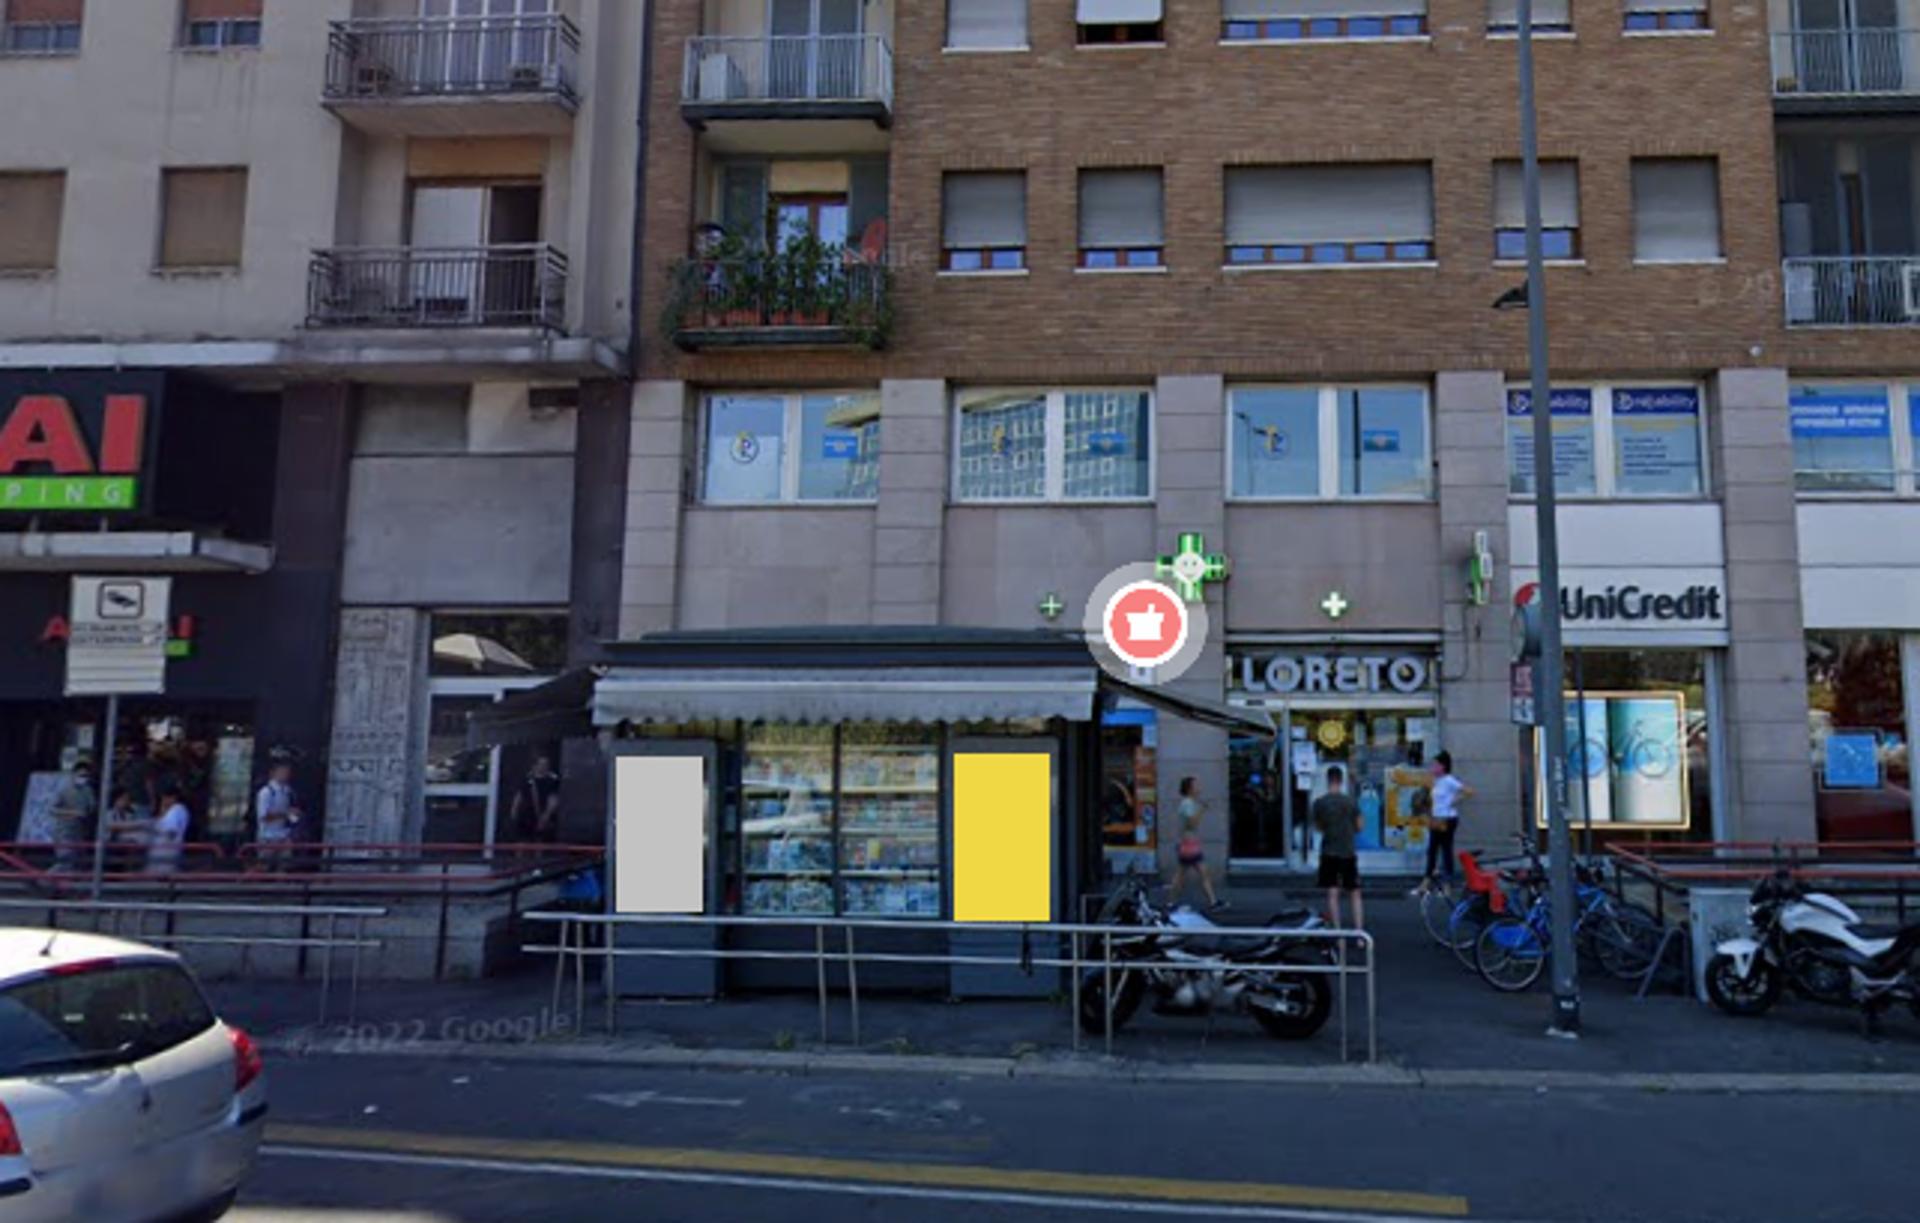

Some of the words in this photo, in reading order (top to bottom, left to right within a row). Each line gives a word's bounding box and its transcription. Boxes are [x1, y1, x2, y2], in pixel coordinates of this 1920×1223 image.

[0, 394, 147, 474] AI
[5, 482, 121, 504] PING
[1561, 585, 1722, 620] UniCredit
[1242, 656, 1425, 693] LORETO
